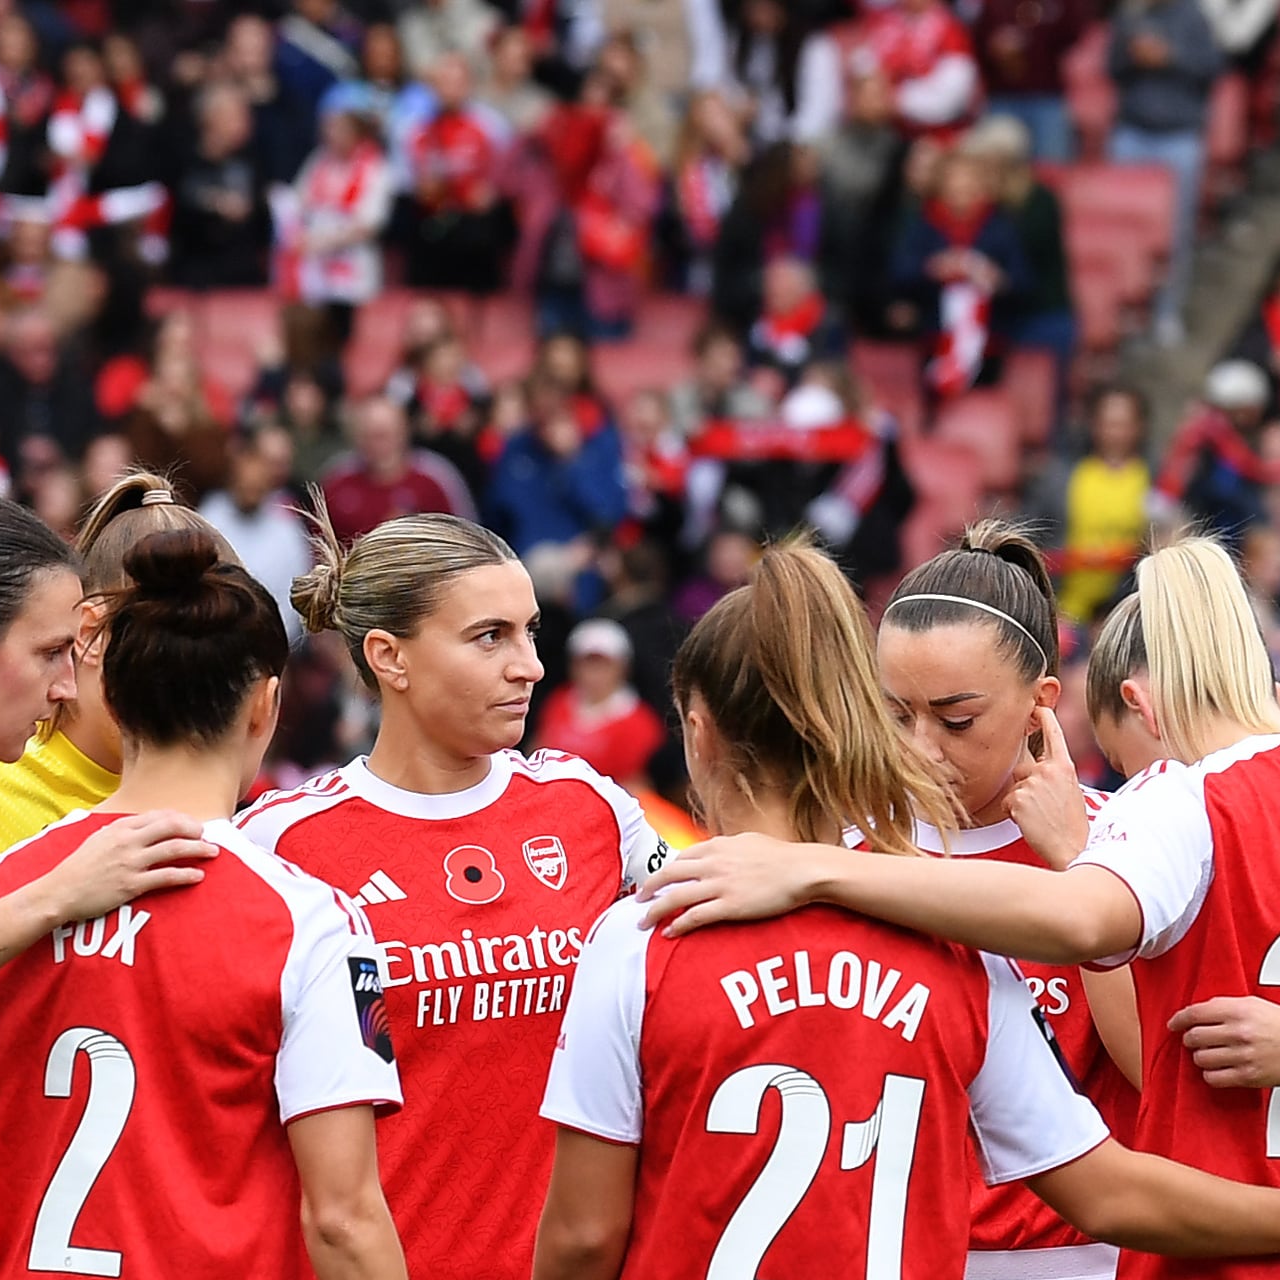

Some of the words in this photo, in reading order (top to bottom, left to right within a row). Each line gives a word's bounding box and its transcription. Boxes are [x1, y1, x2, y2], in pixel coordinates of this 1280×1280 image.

[52, 904, 152, 968] FOX
[375, 924, 582, 990] Emirates
[416, 985, 464, 1029] FLY
[472, 973, 567, 1022] BETTER
[719, 949, 931, 1043] PELOVA
[26, 1025, 137, 1280] 2
